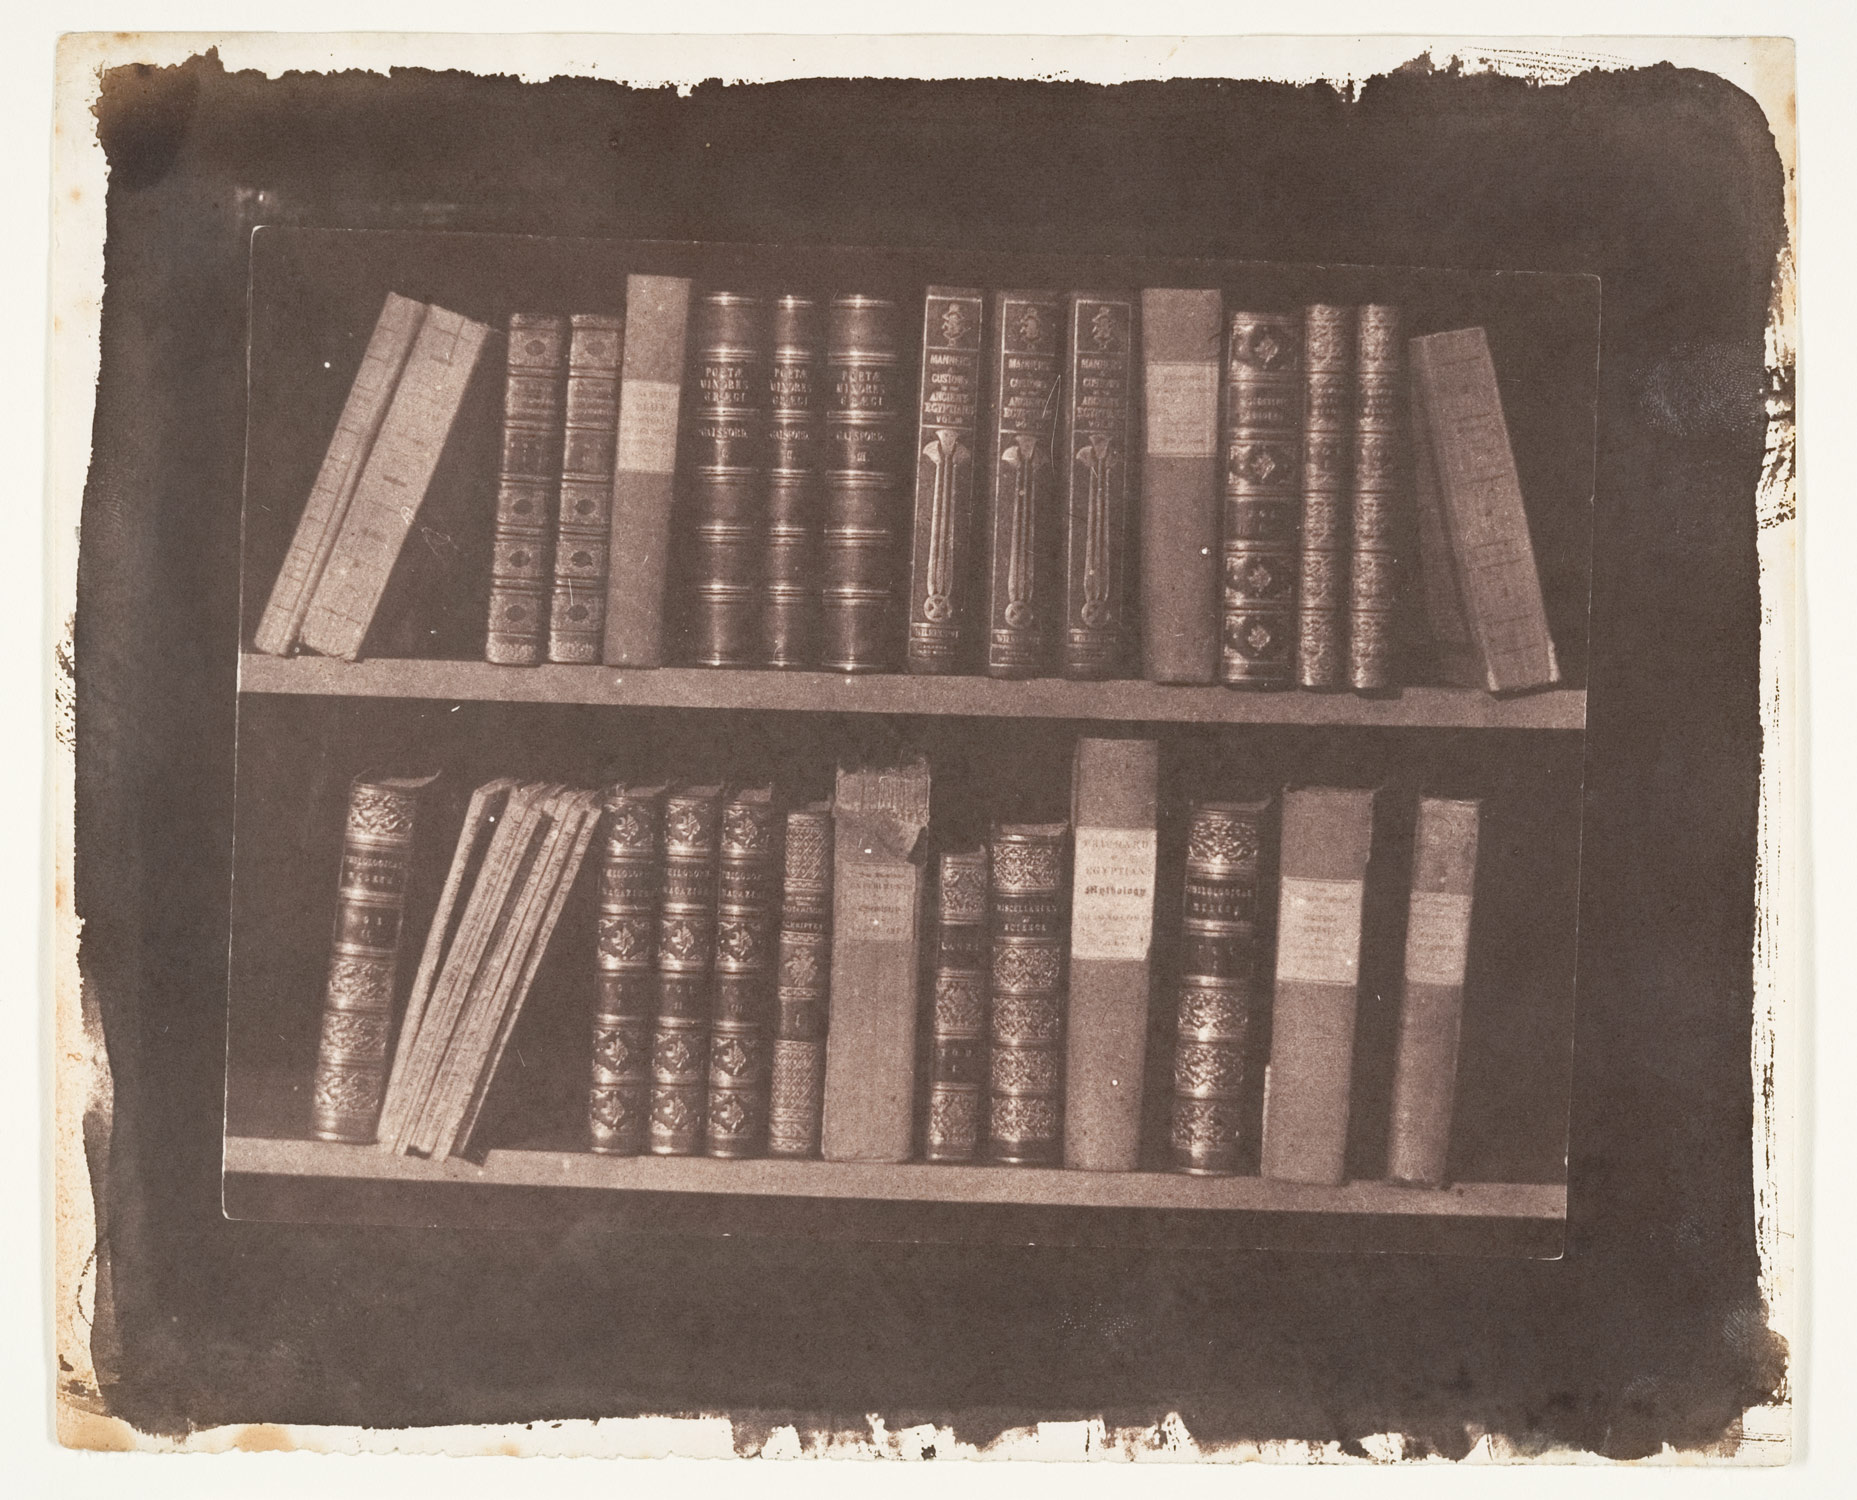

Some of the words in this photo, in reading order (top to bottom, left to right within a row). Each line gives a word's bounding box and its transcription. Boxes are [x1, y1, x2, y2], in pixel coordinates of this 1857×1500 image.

[930, 354, 972, 366] MANNERS
[931, 373, 969, 385] CUSTOMS
[1085, 884, 1147, 898] Mythology
